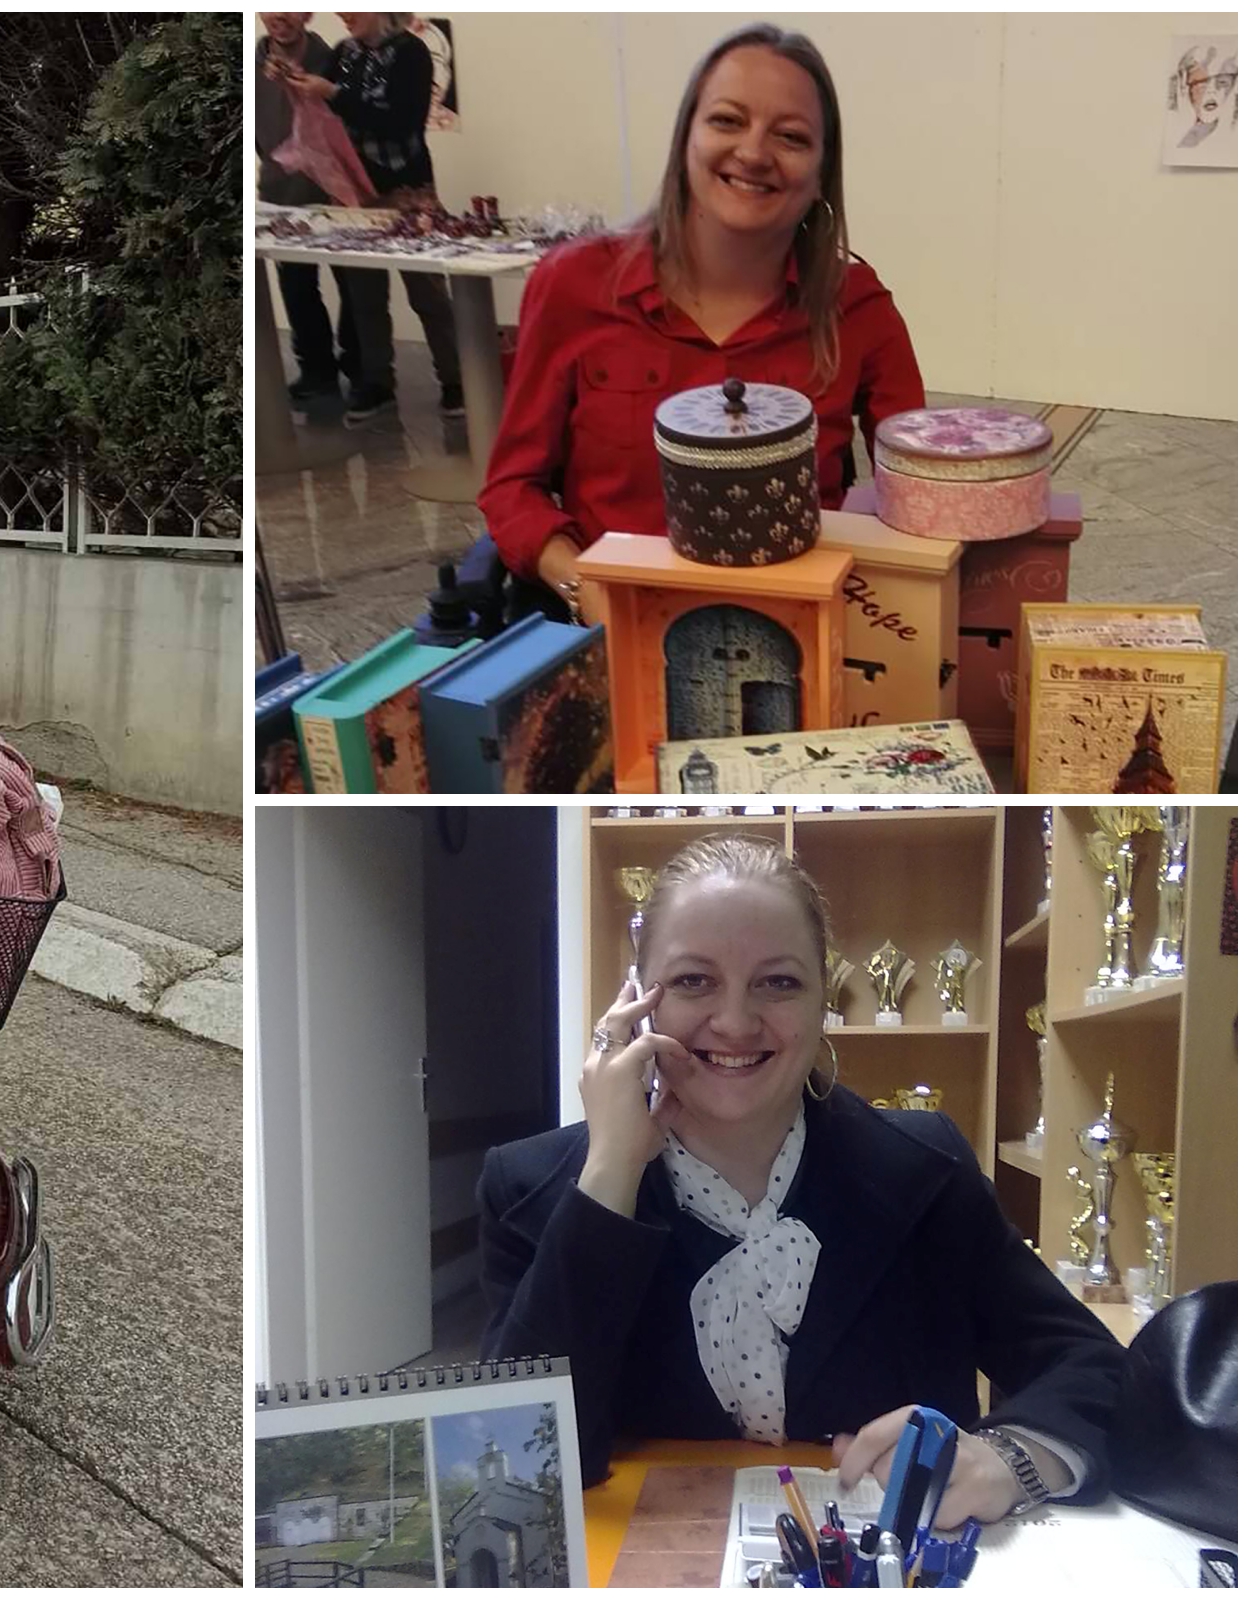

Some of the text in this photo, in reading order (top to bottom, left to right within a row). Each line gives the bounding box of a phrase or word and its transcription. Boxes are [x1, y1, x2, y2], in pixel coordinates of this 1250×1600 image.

[843, 574, 918, 641] Hope
[1050, 663, 1074, 680] The
[1142, 667, 1185, 684] Times
